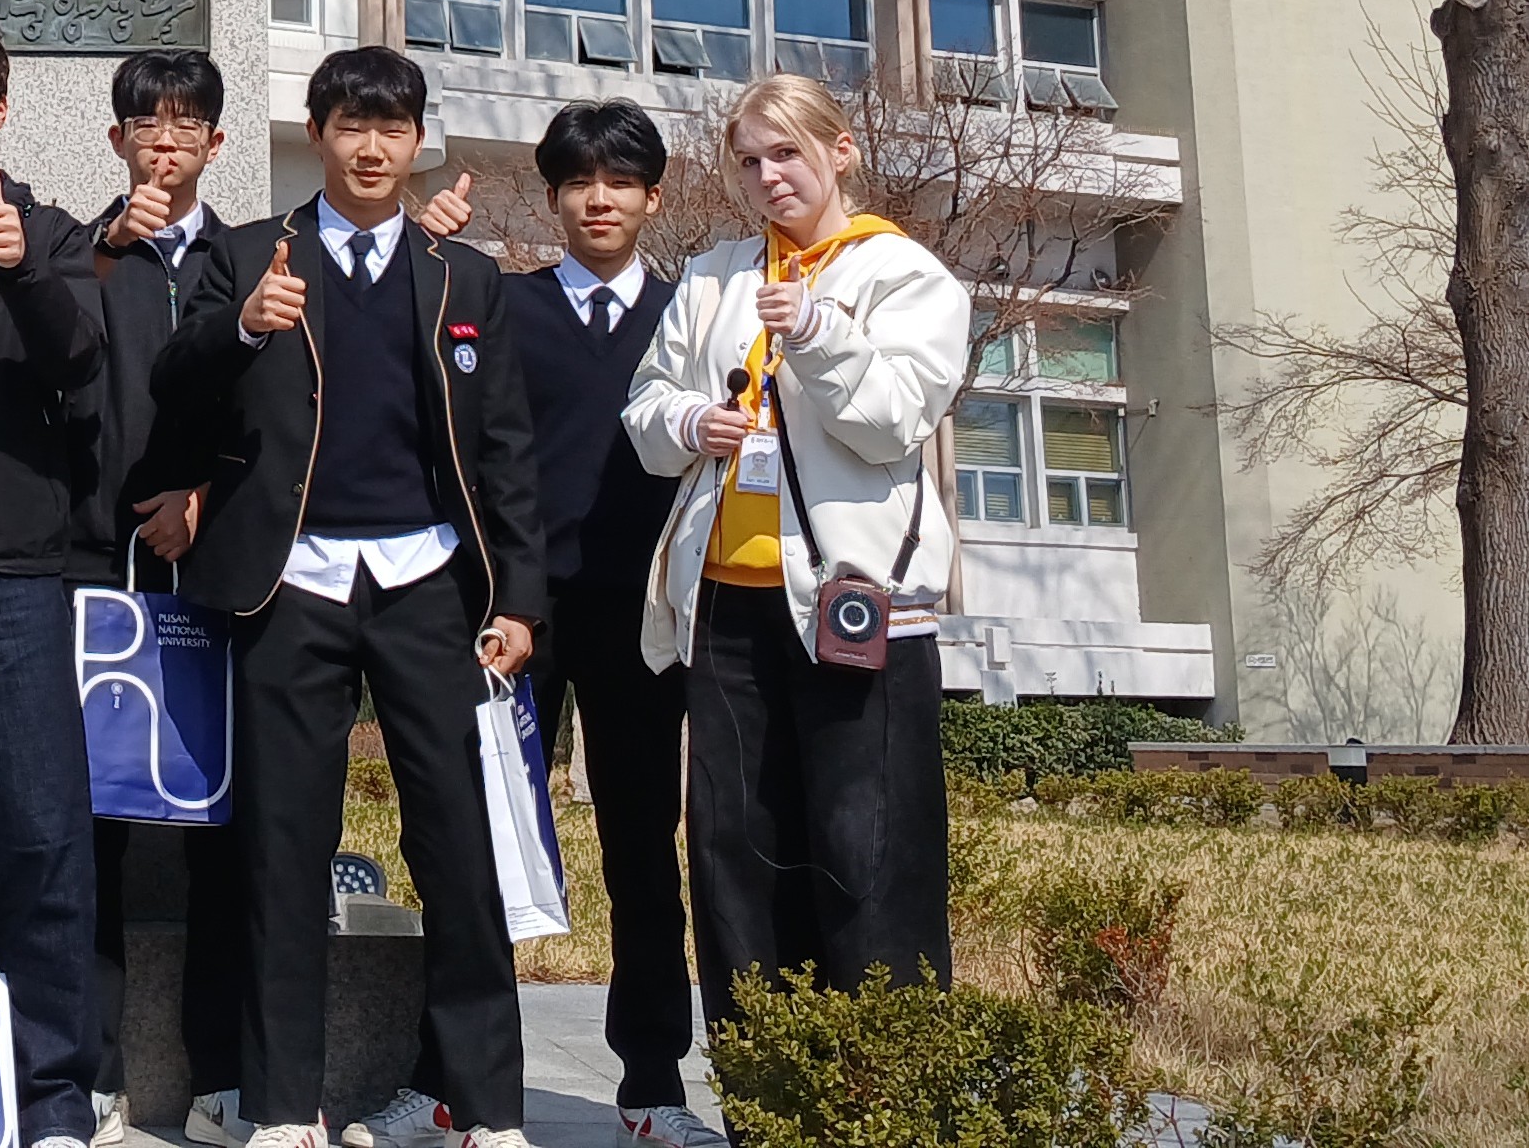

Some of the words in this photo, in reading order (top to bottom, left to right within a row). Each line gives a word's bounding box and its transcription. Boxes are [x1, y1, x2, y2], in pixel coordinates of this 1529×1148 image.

[158, 613, 190, 623] PUSAN
[158, 625, 206, 636] NATIONAL
[158, 636, 211, 648] UNIVERSITY
